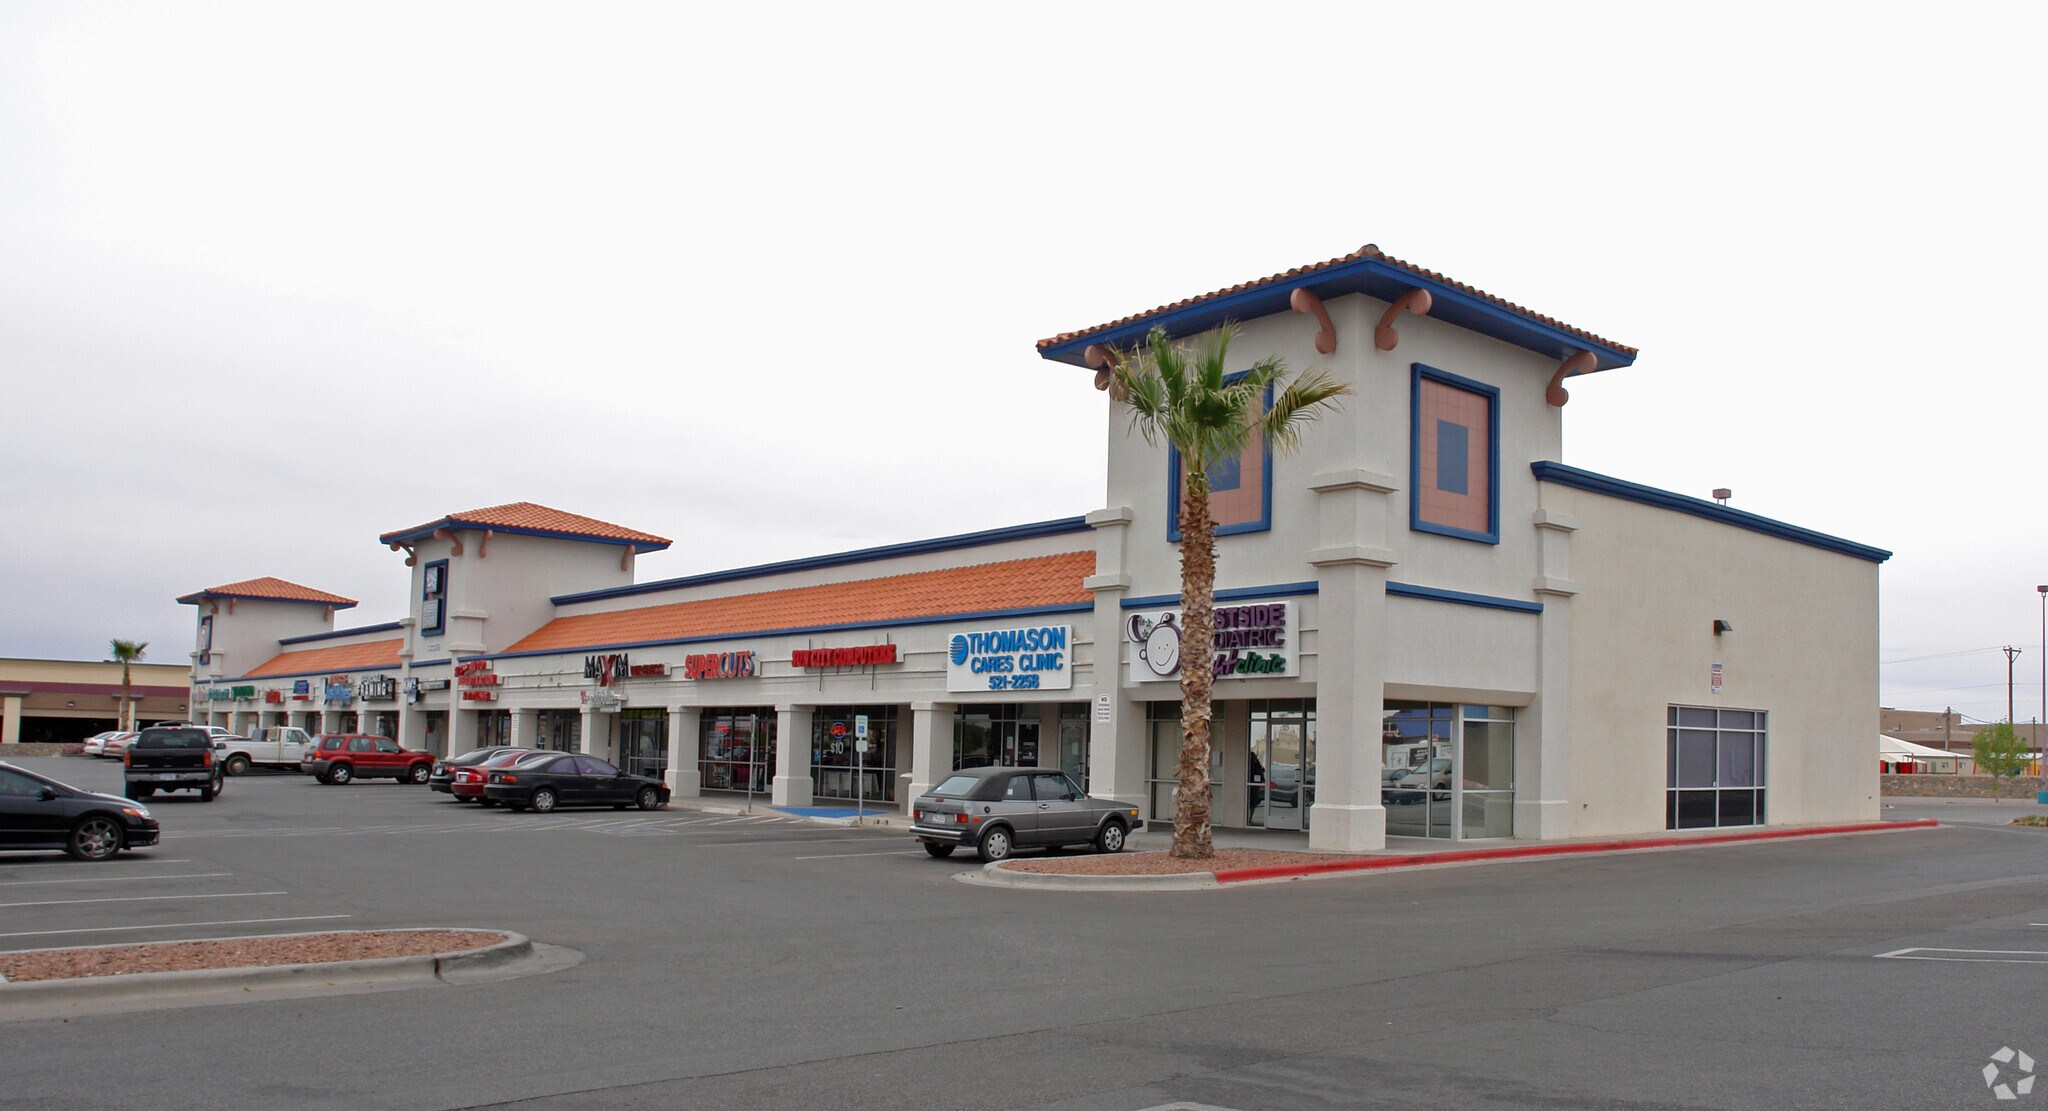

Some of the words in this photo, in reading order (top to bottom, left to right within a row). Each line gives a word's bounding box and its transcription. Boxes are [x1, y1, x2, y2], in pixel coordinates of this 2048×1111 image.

[1214, 604, 1286, 629] STSIDE
[967, 627, 1066, 654] THOMASON
[1214, 627, 1286, 649] DIATRIC
[685, 650, 756, 679] SUPERCUTS
[811, 648, 833, 667] CITY
[971, 655, 1014, 673] CARES
[1018, 652, 1063, 671] CLINIC
[584, 653, 629, 687] MAXIM
[988, 674, 1039, 690] 521-2258
[830, 742, 844, 755] $10
